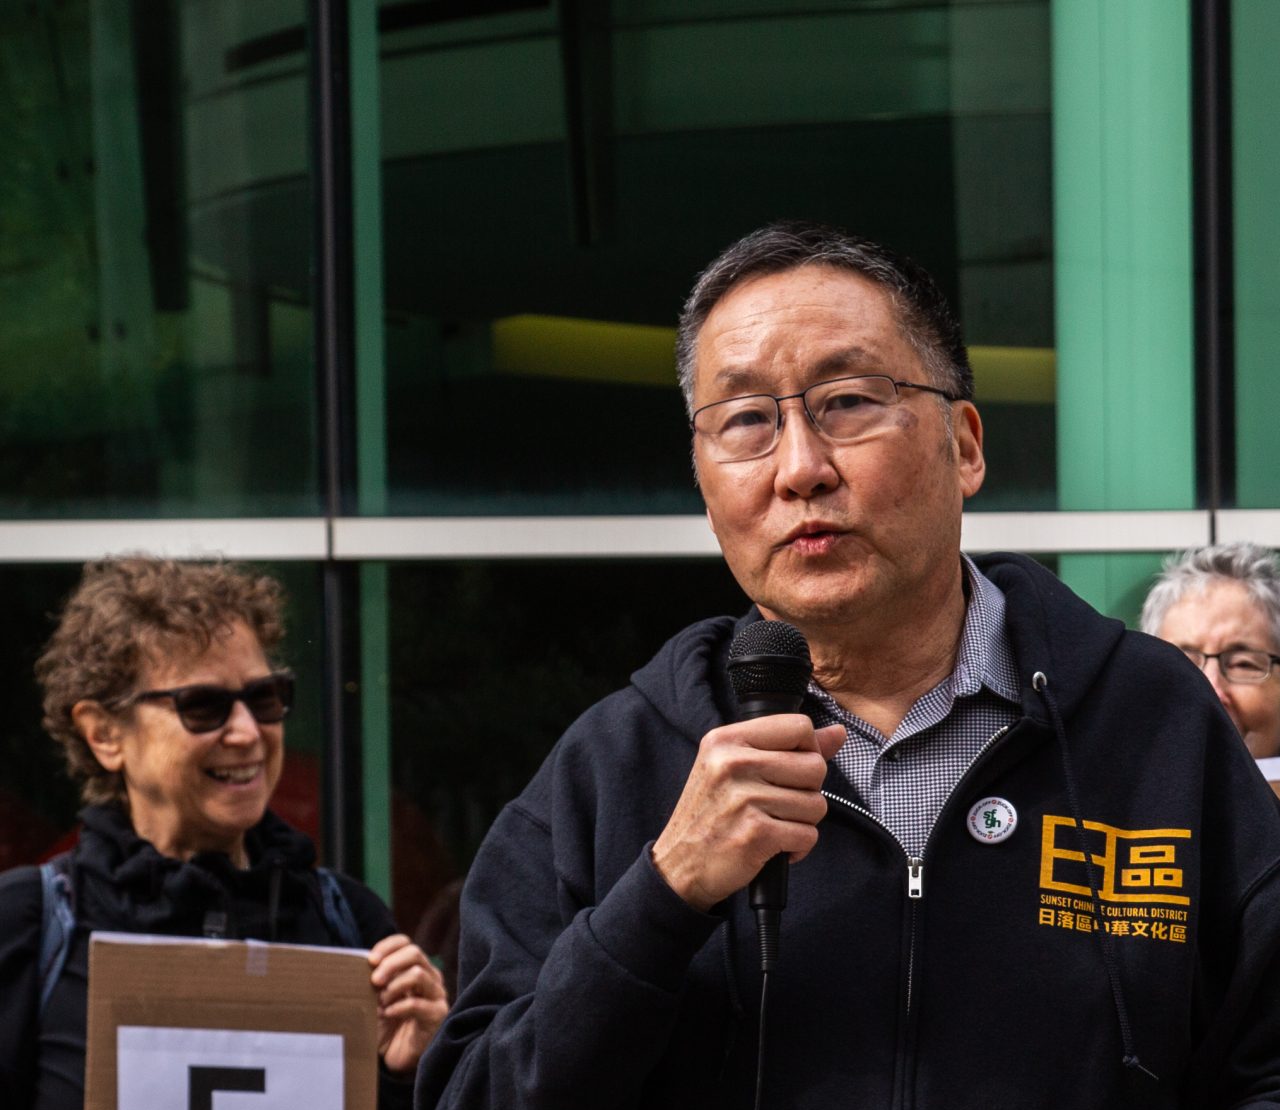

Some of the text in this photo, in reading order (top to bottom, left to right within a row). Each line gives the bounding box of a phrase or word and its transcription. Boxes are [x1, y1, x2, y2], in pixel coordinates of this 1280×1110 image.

[983, 809, 997, 819] sf
[1040, 894, 1188, 921] SUNSET CHINE CULTURAL DISTRICT
